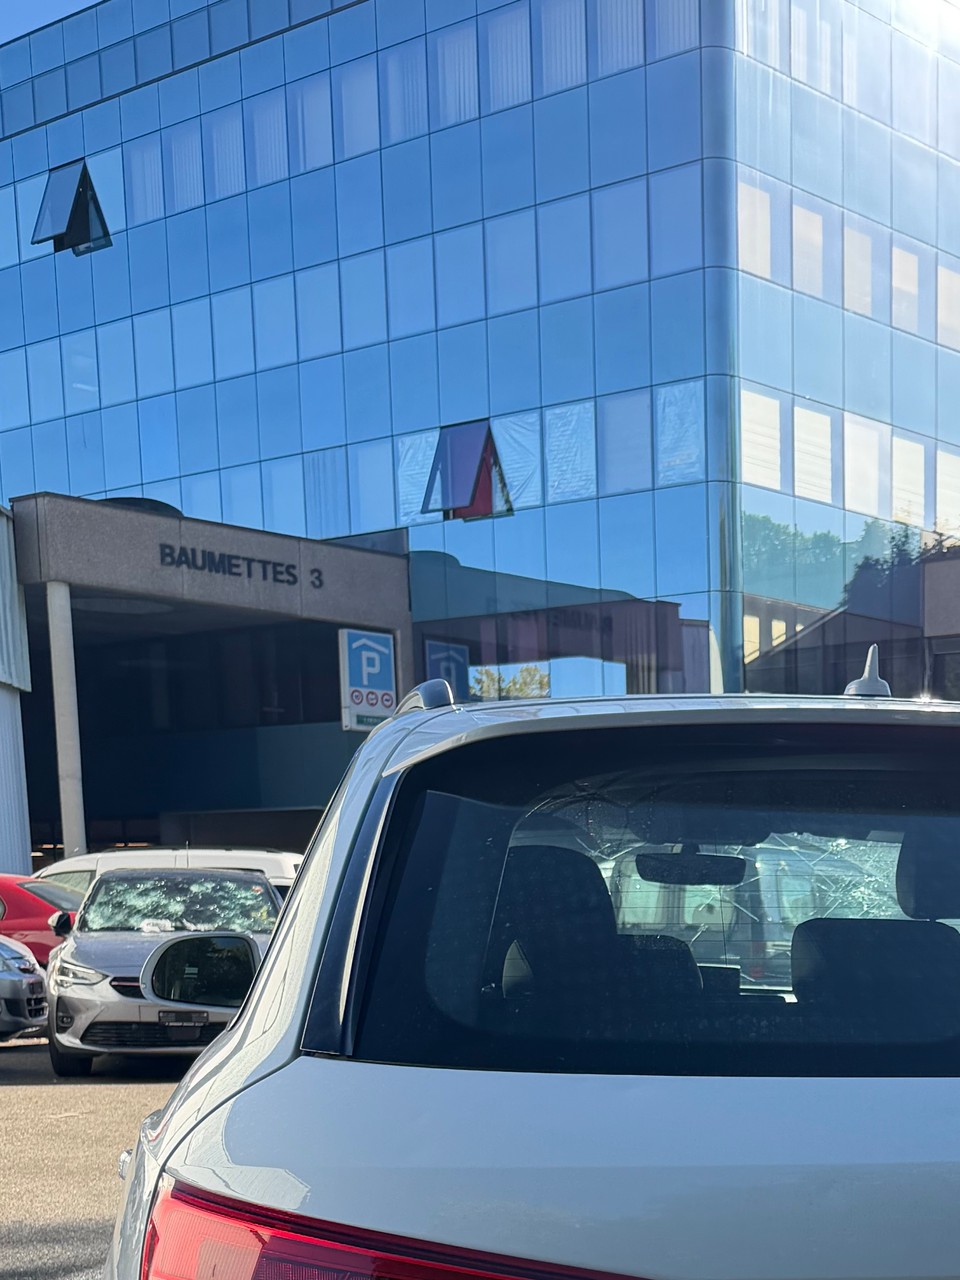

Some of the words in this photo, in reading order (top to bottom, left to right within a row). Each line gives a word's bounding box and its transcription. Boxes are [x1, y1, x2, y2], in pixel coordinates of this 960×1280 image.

[158, 543, 299, 586] BAUMETTES
[309, 567, 325, 590] 3
[361, 650, 381, 687] P
